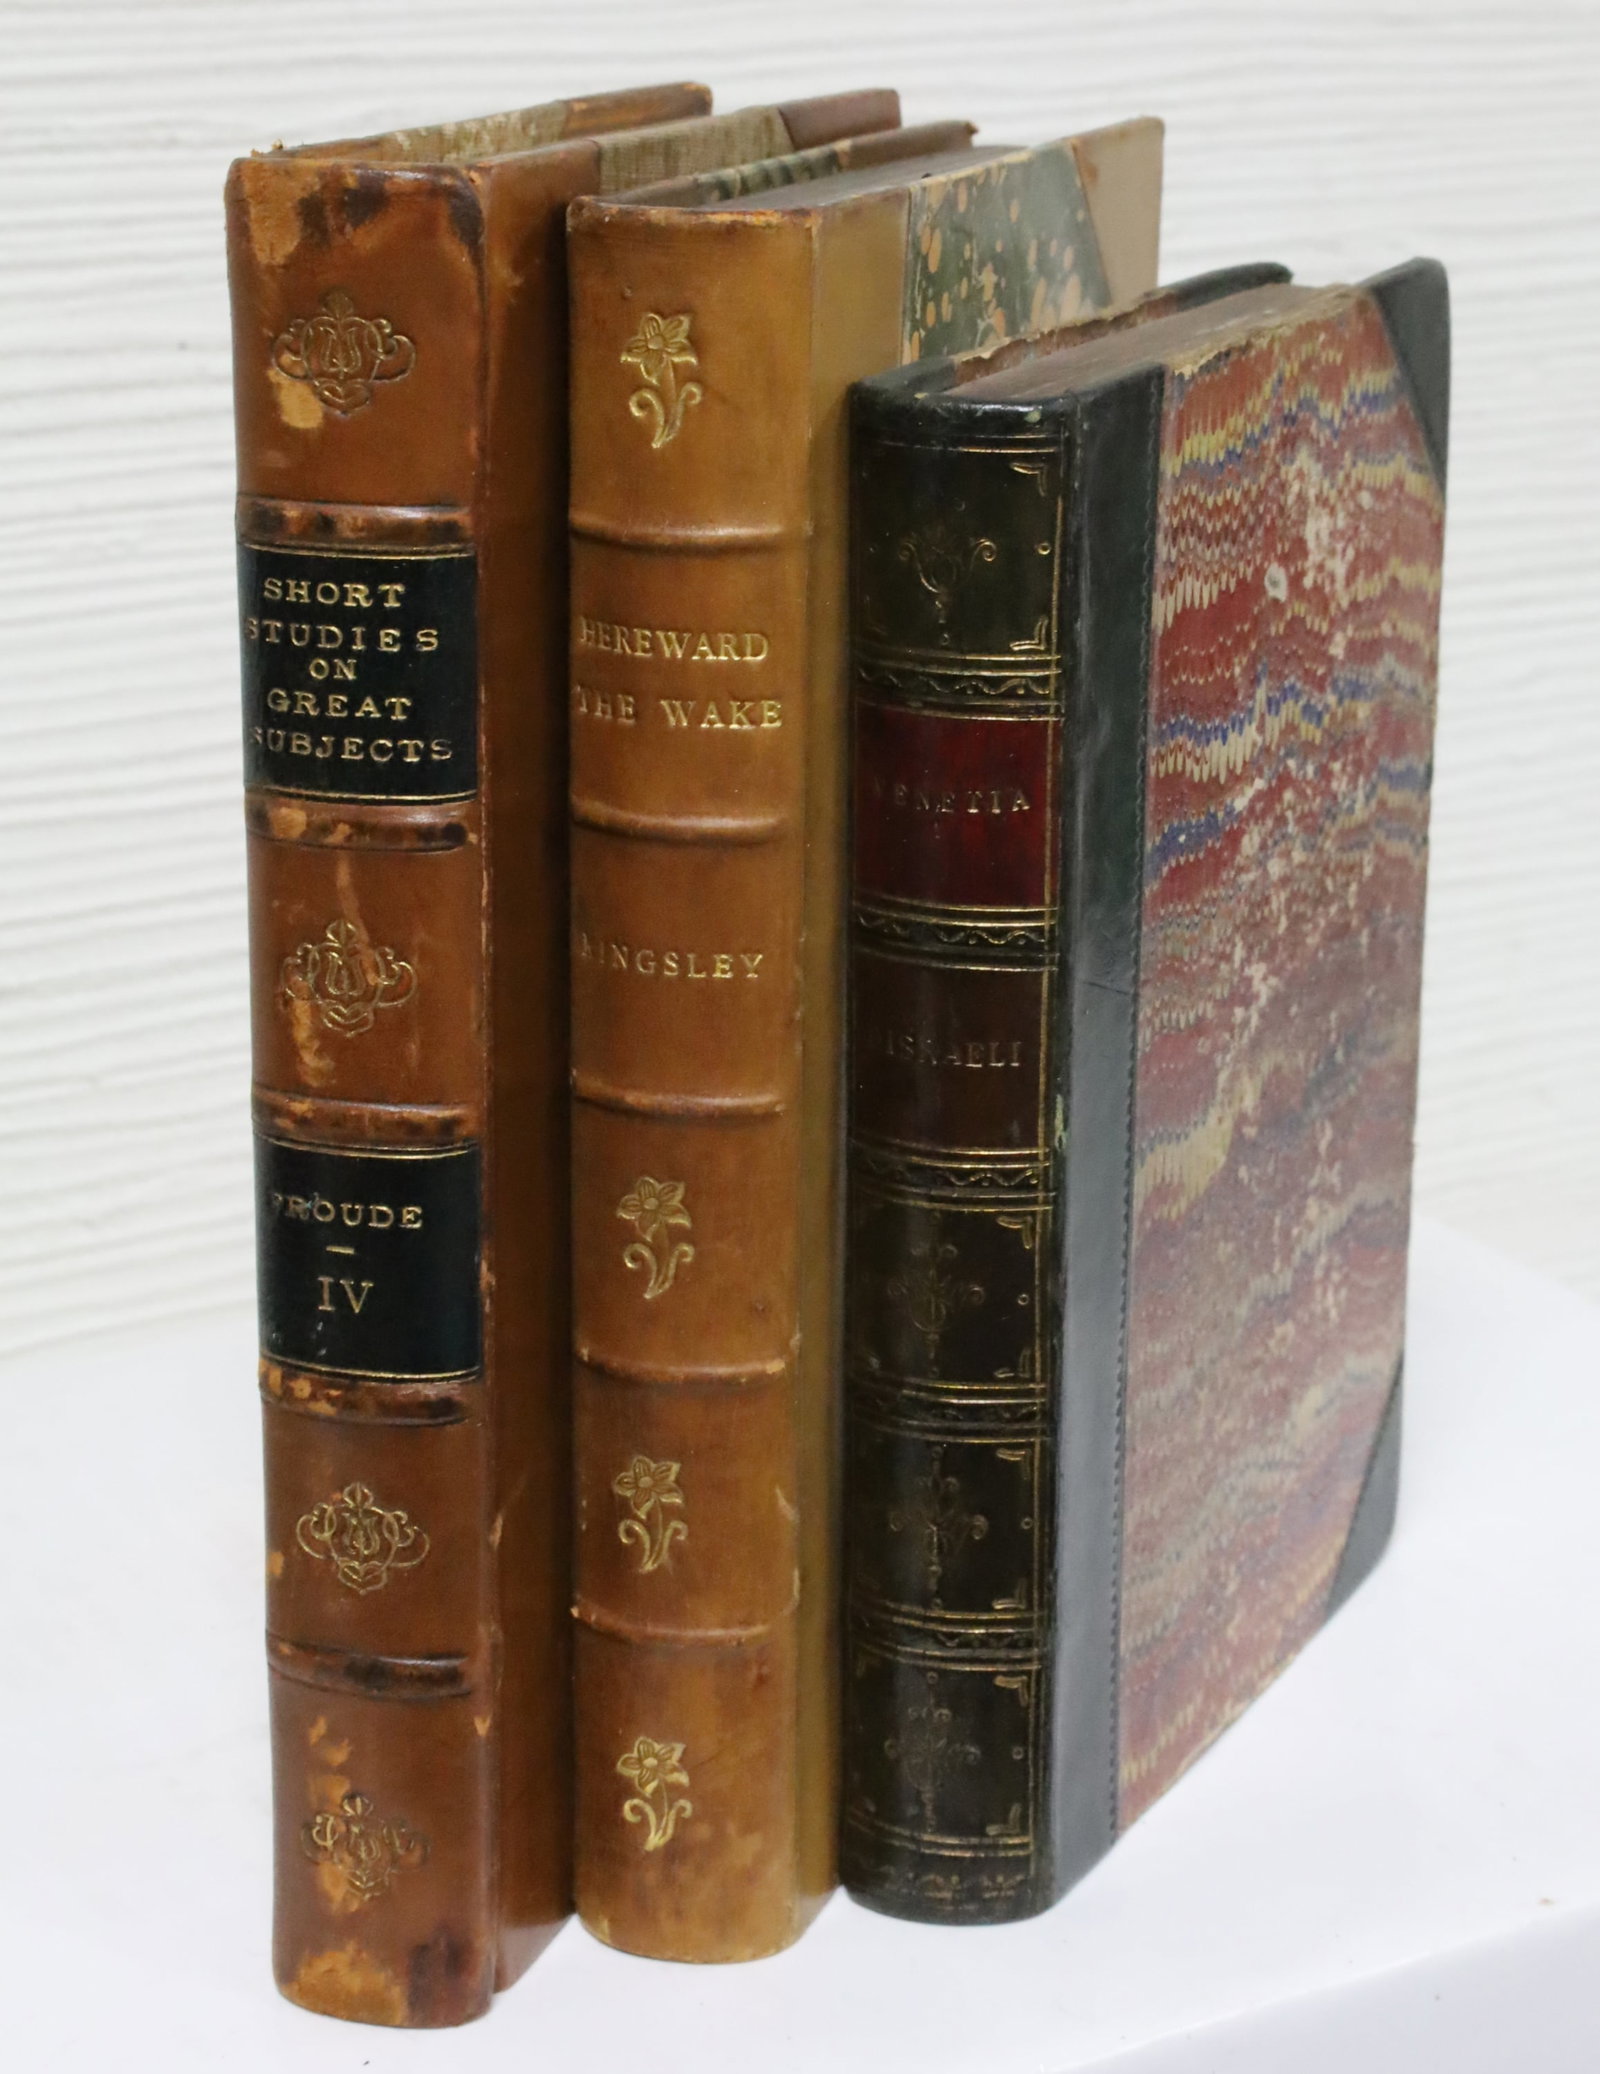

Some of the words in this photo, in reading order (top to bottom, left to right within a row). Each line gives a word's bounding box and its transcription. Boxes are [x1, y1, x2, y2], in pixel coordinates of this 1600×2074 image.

[263, 577, 406, 608] SHORT
[244, 617, 439, 652] STUDIES
[578, 616, 770, 661] HEREWARD
[308, 657, 358, 680] ON
[266, 687, 413, 721] GREAT
[572, 684, 636, 725] THE
[659, 698, 783, 729] WAKE
[250, 726, 453, 763] SUBJECTS
[317, 1275, 375, 1315] IV
